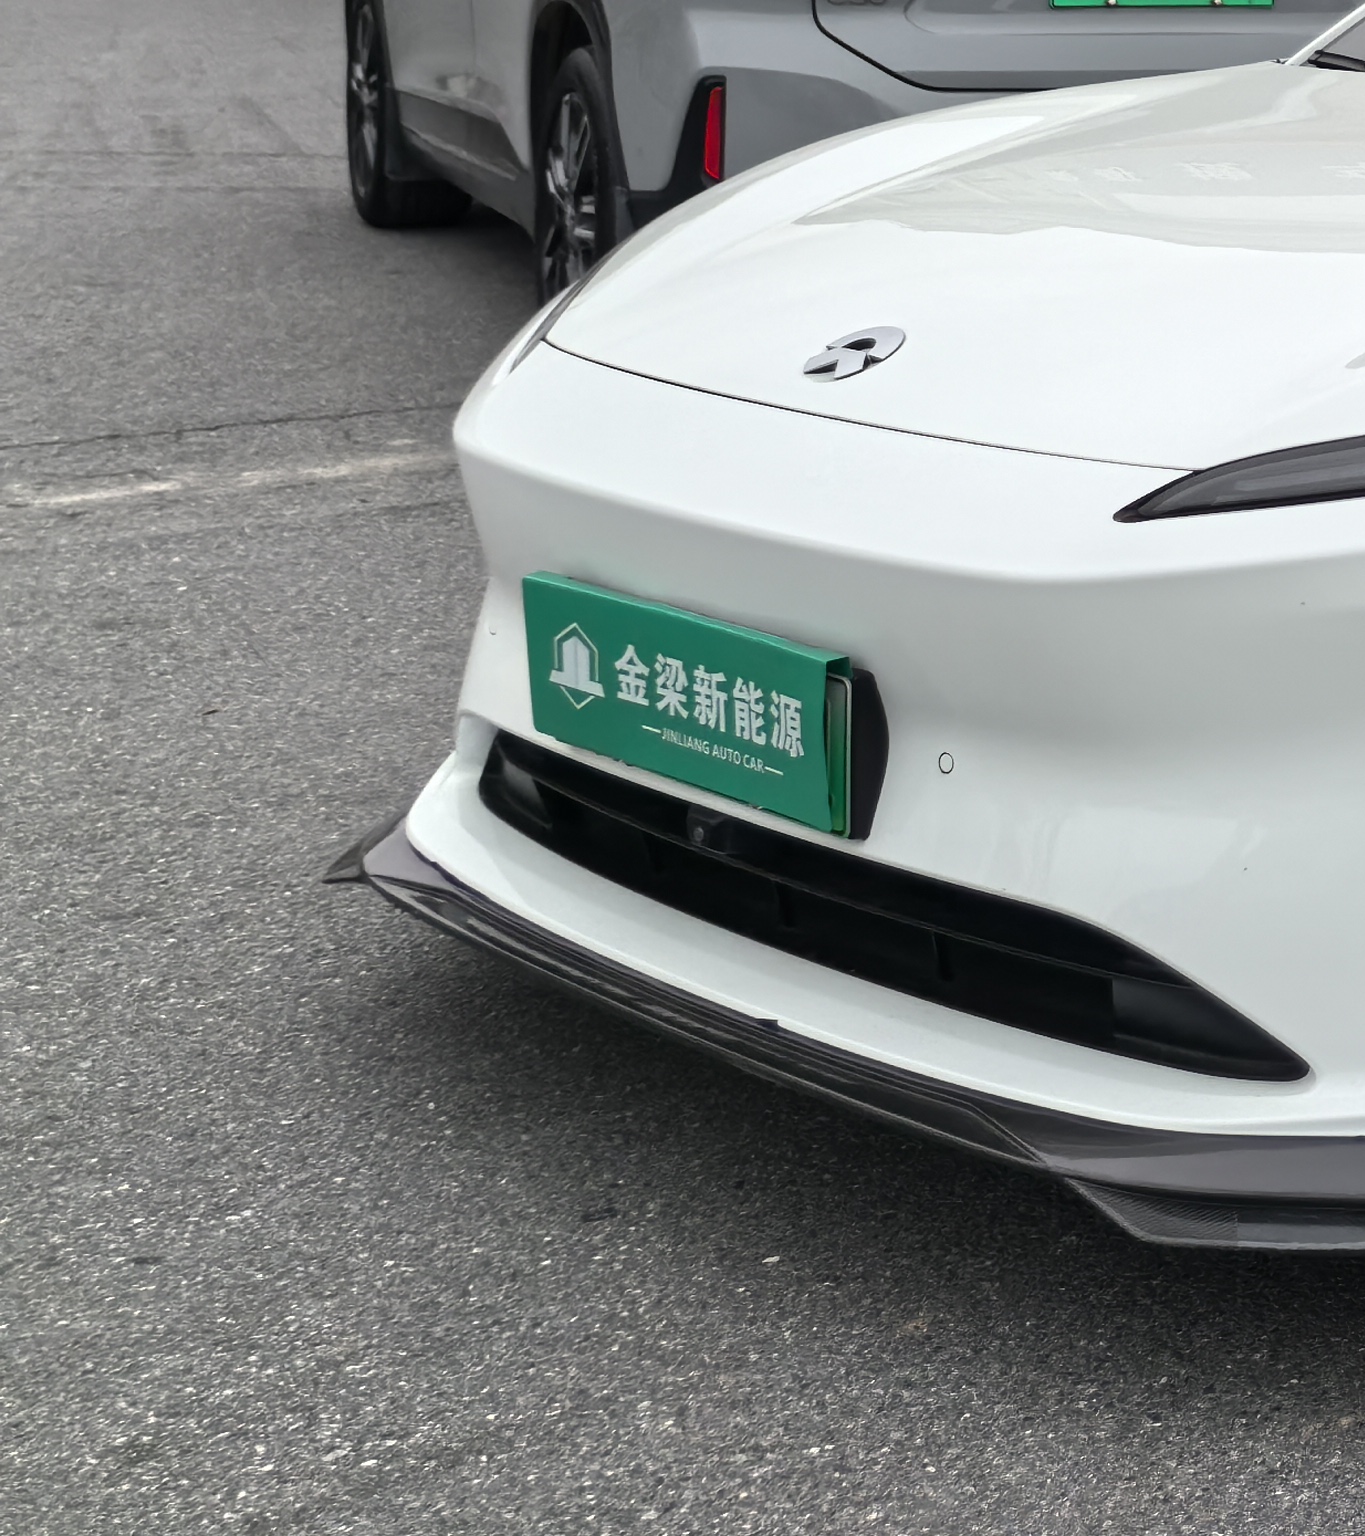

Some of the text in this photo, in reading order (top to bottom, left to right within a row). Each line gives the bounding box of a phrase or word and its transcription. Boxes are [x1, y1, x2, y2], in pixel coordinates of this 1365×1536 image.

[614, 644, 806, 759] 金梁新能源
[661, 727, 765, 773] JINLIANG AUTO CAR
